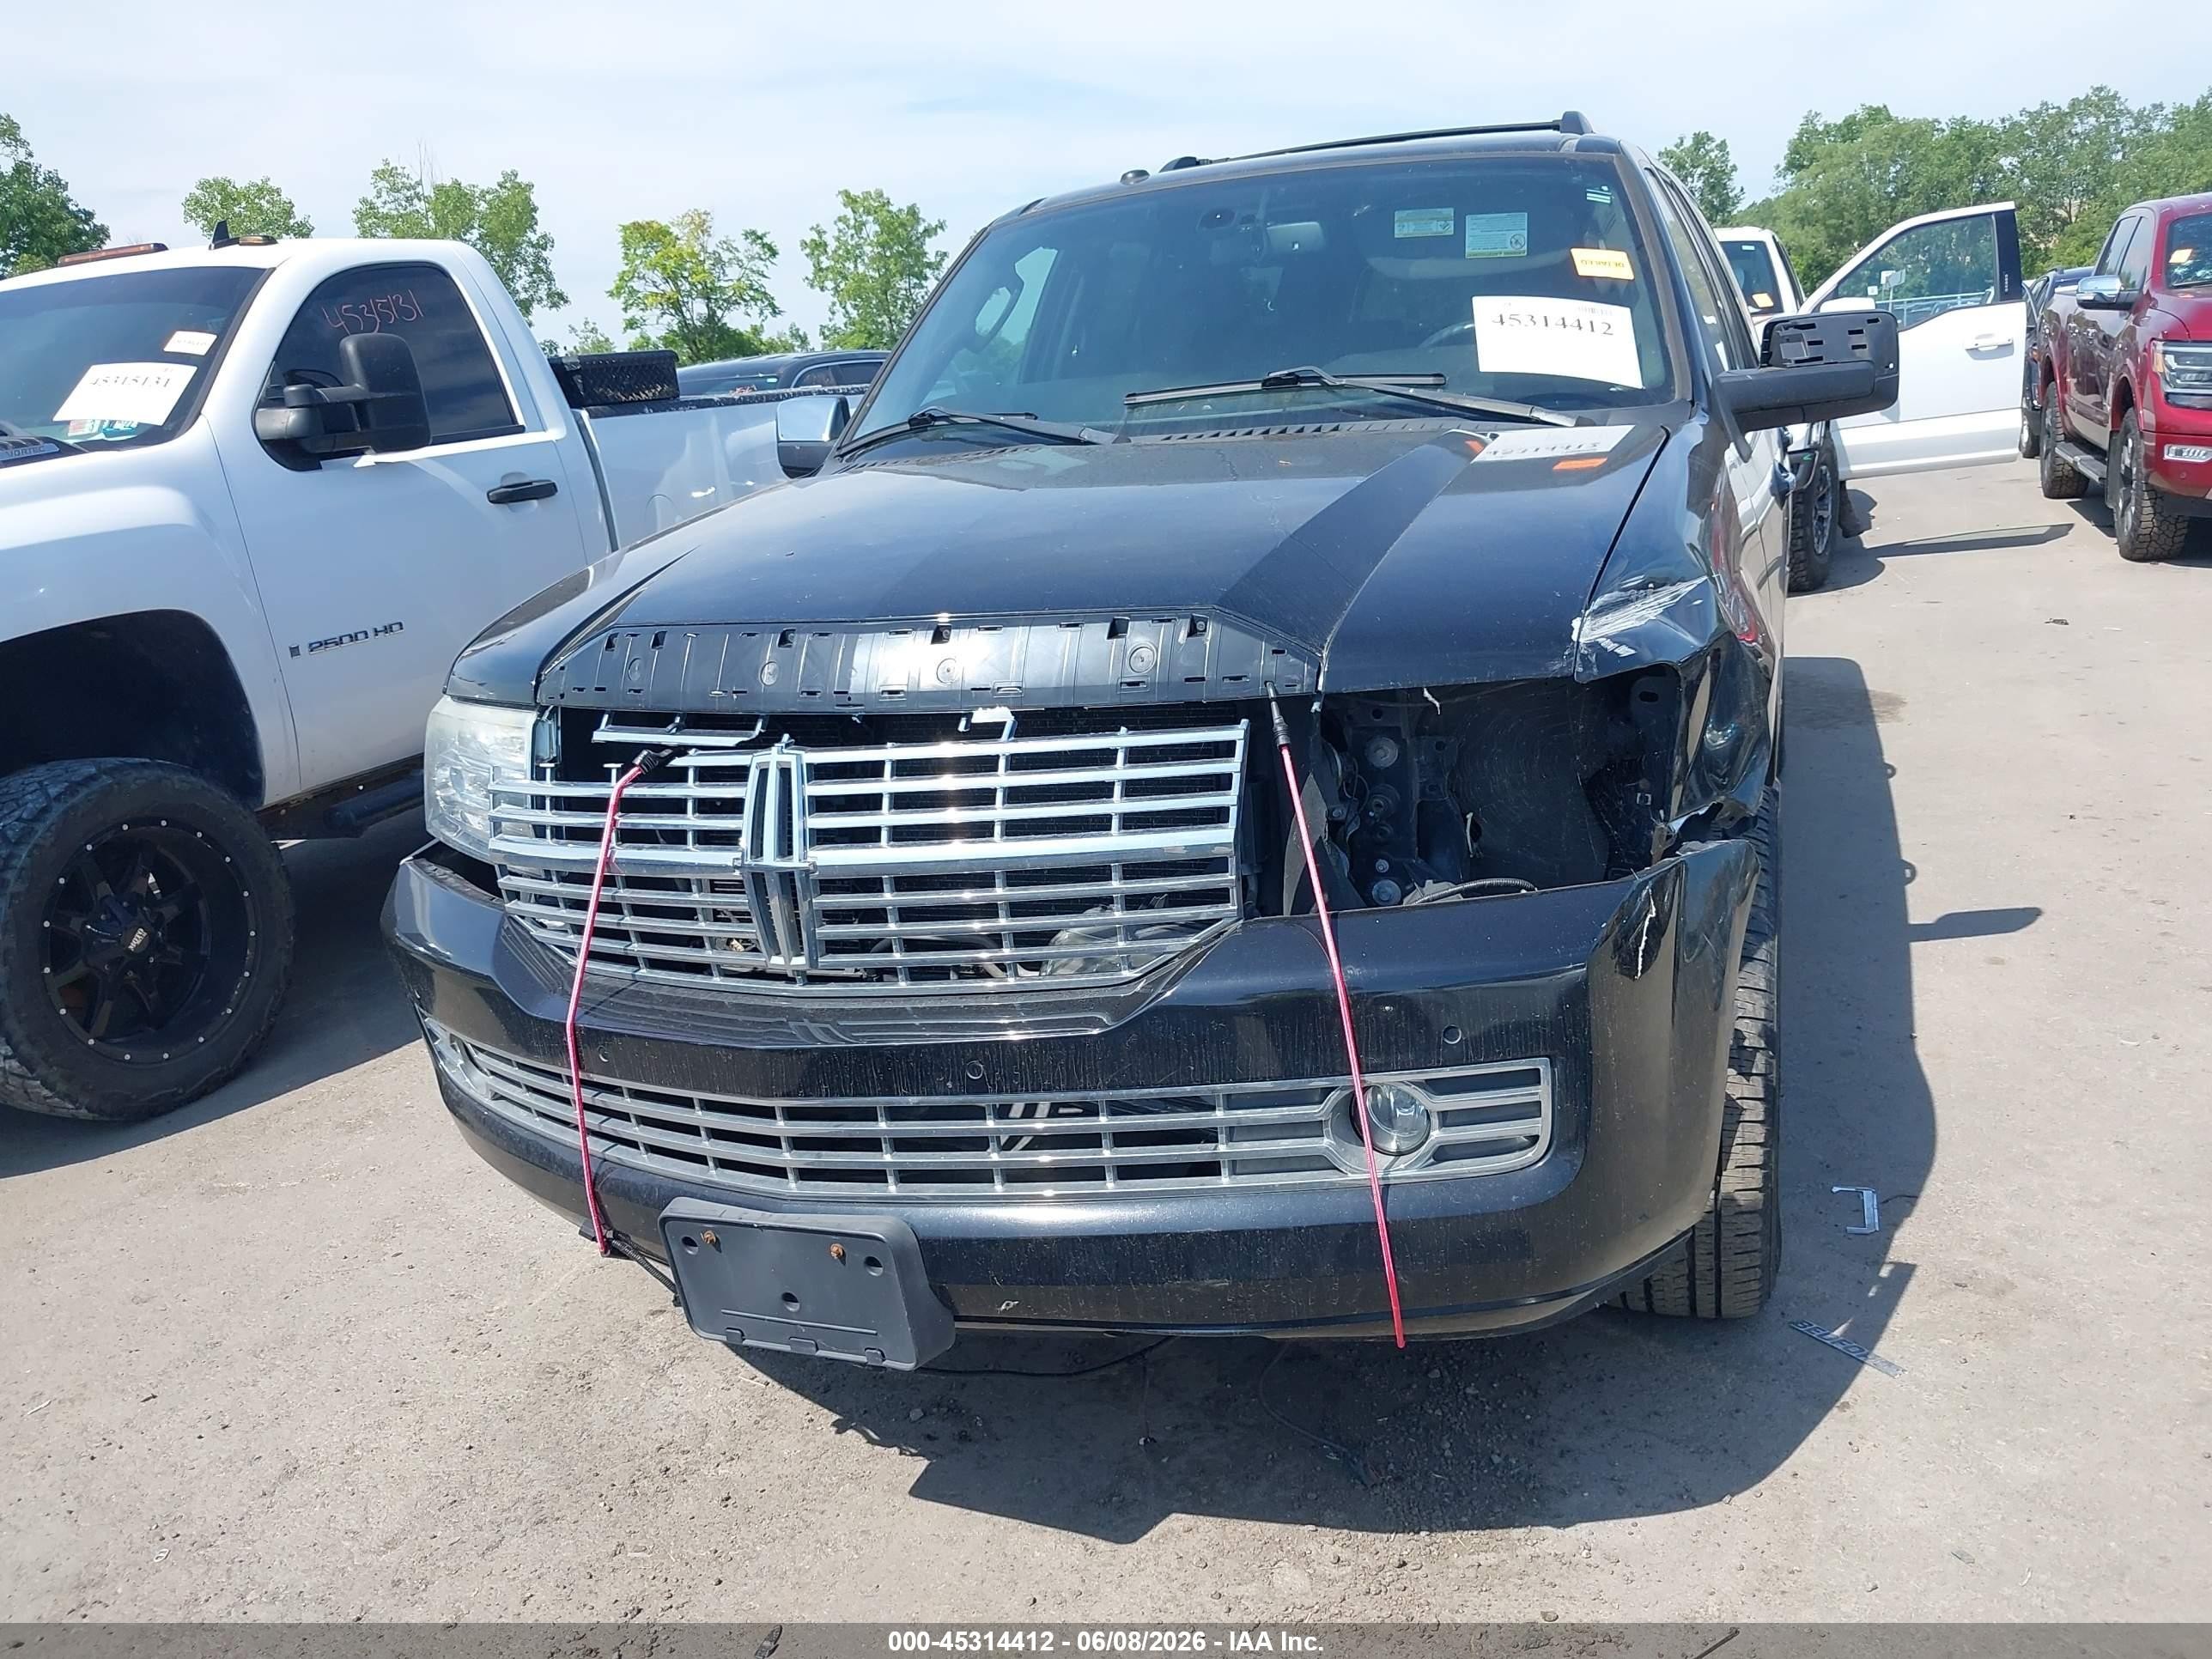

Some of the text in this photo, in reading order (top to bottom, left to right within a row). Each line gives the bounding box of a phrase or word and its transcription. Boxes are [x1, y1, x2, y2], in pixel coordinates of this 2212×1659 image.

[321, 289, 424, 336] 45315131
[1491, 313, 1614, 336] 45314412
[307, 621, 404, 654] 2500 HD
